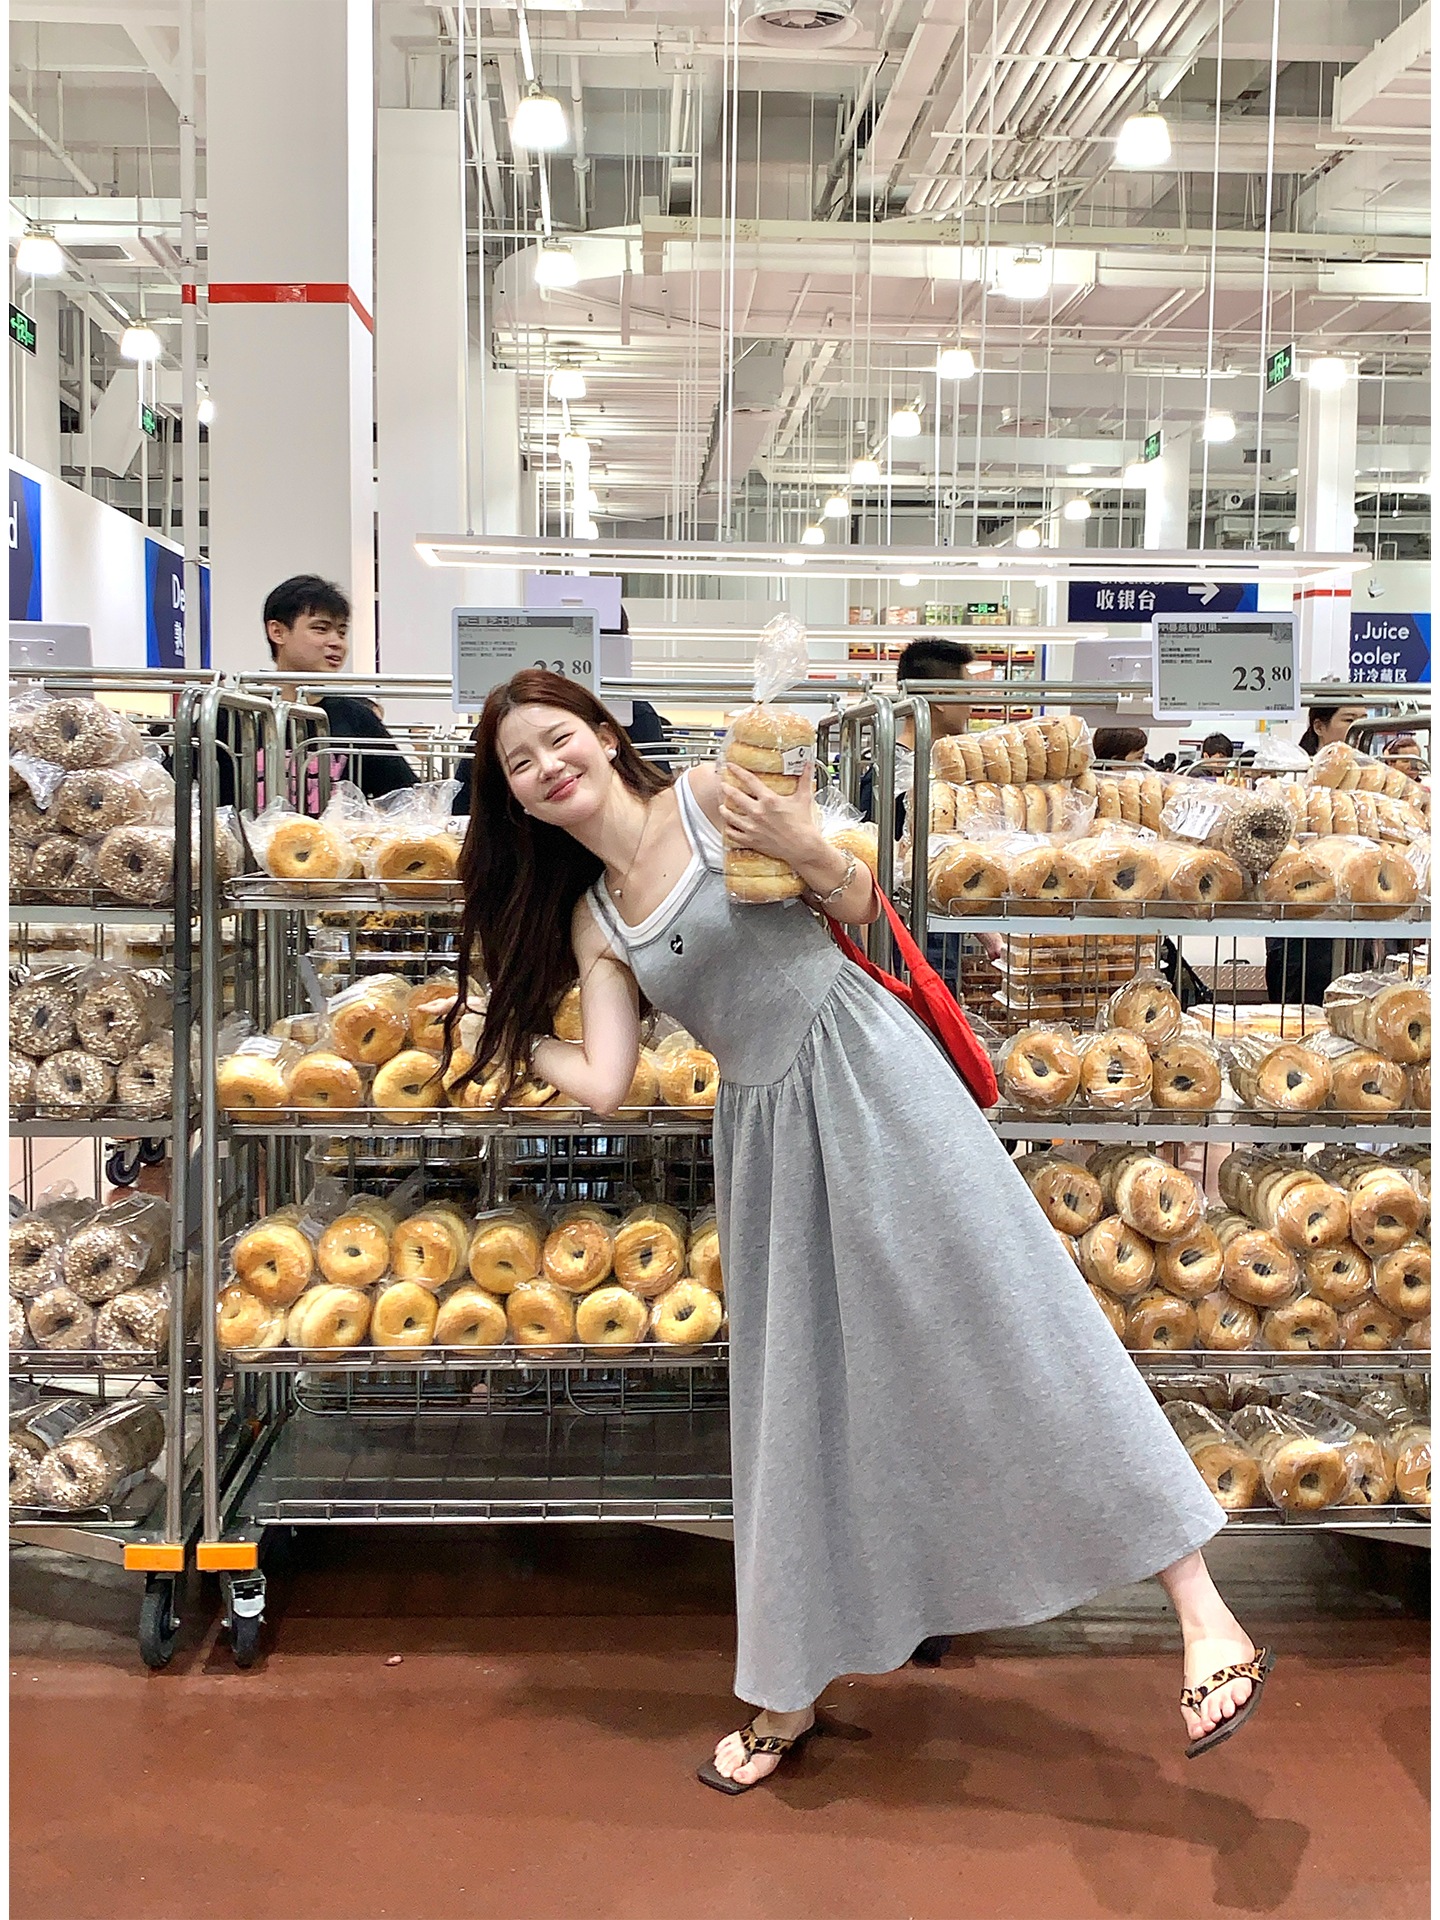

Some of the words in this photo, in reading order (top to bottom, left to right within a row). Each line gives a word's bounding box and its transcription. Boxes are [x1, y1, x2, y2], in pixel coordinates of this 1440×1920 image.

[1096, 589, 1156, 611] 收银台
[1349, 646, 1401, 664] ooler
[1349, 668, 1408, 683] 汁冷藏区
